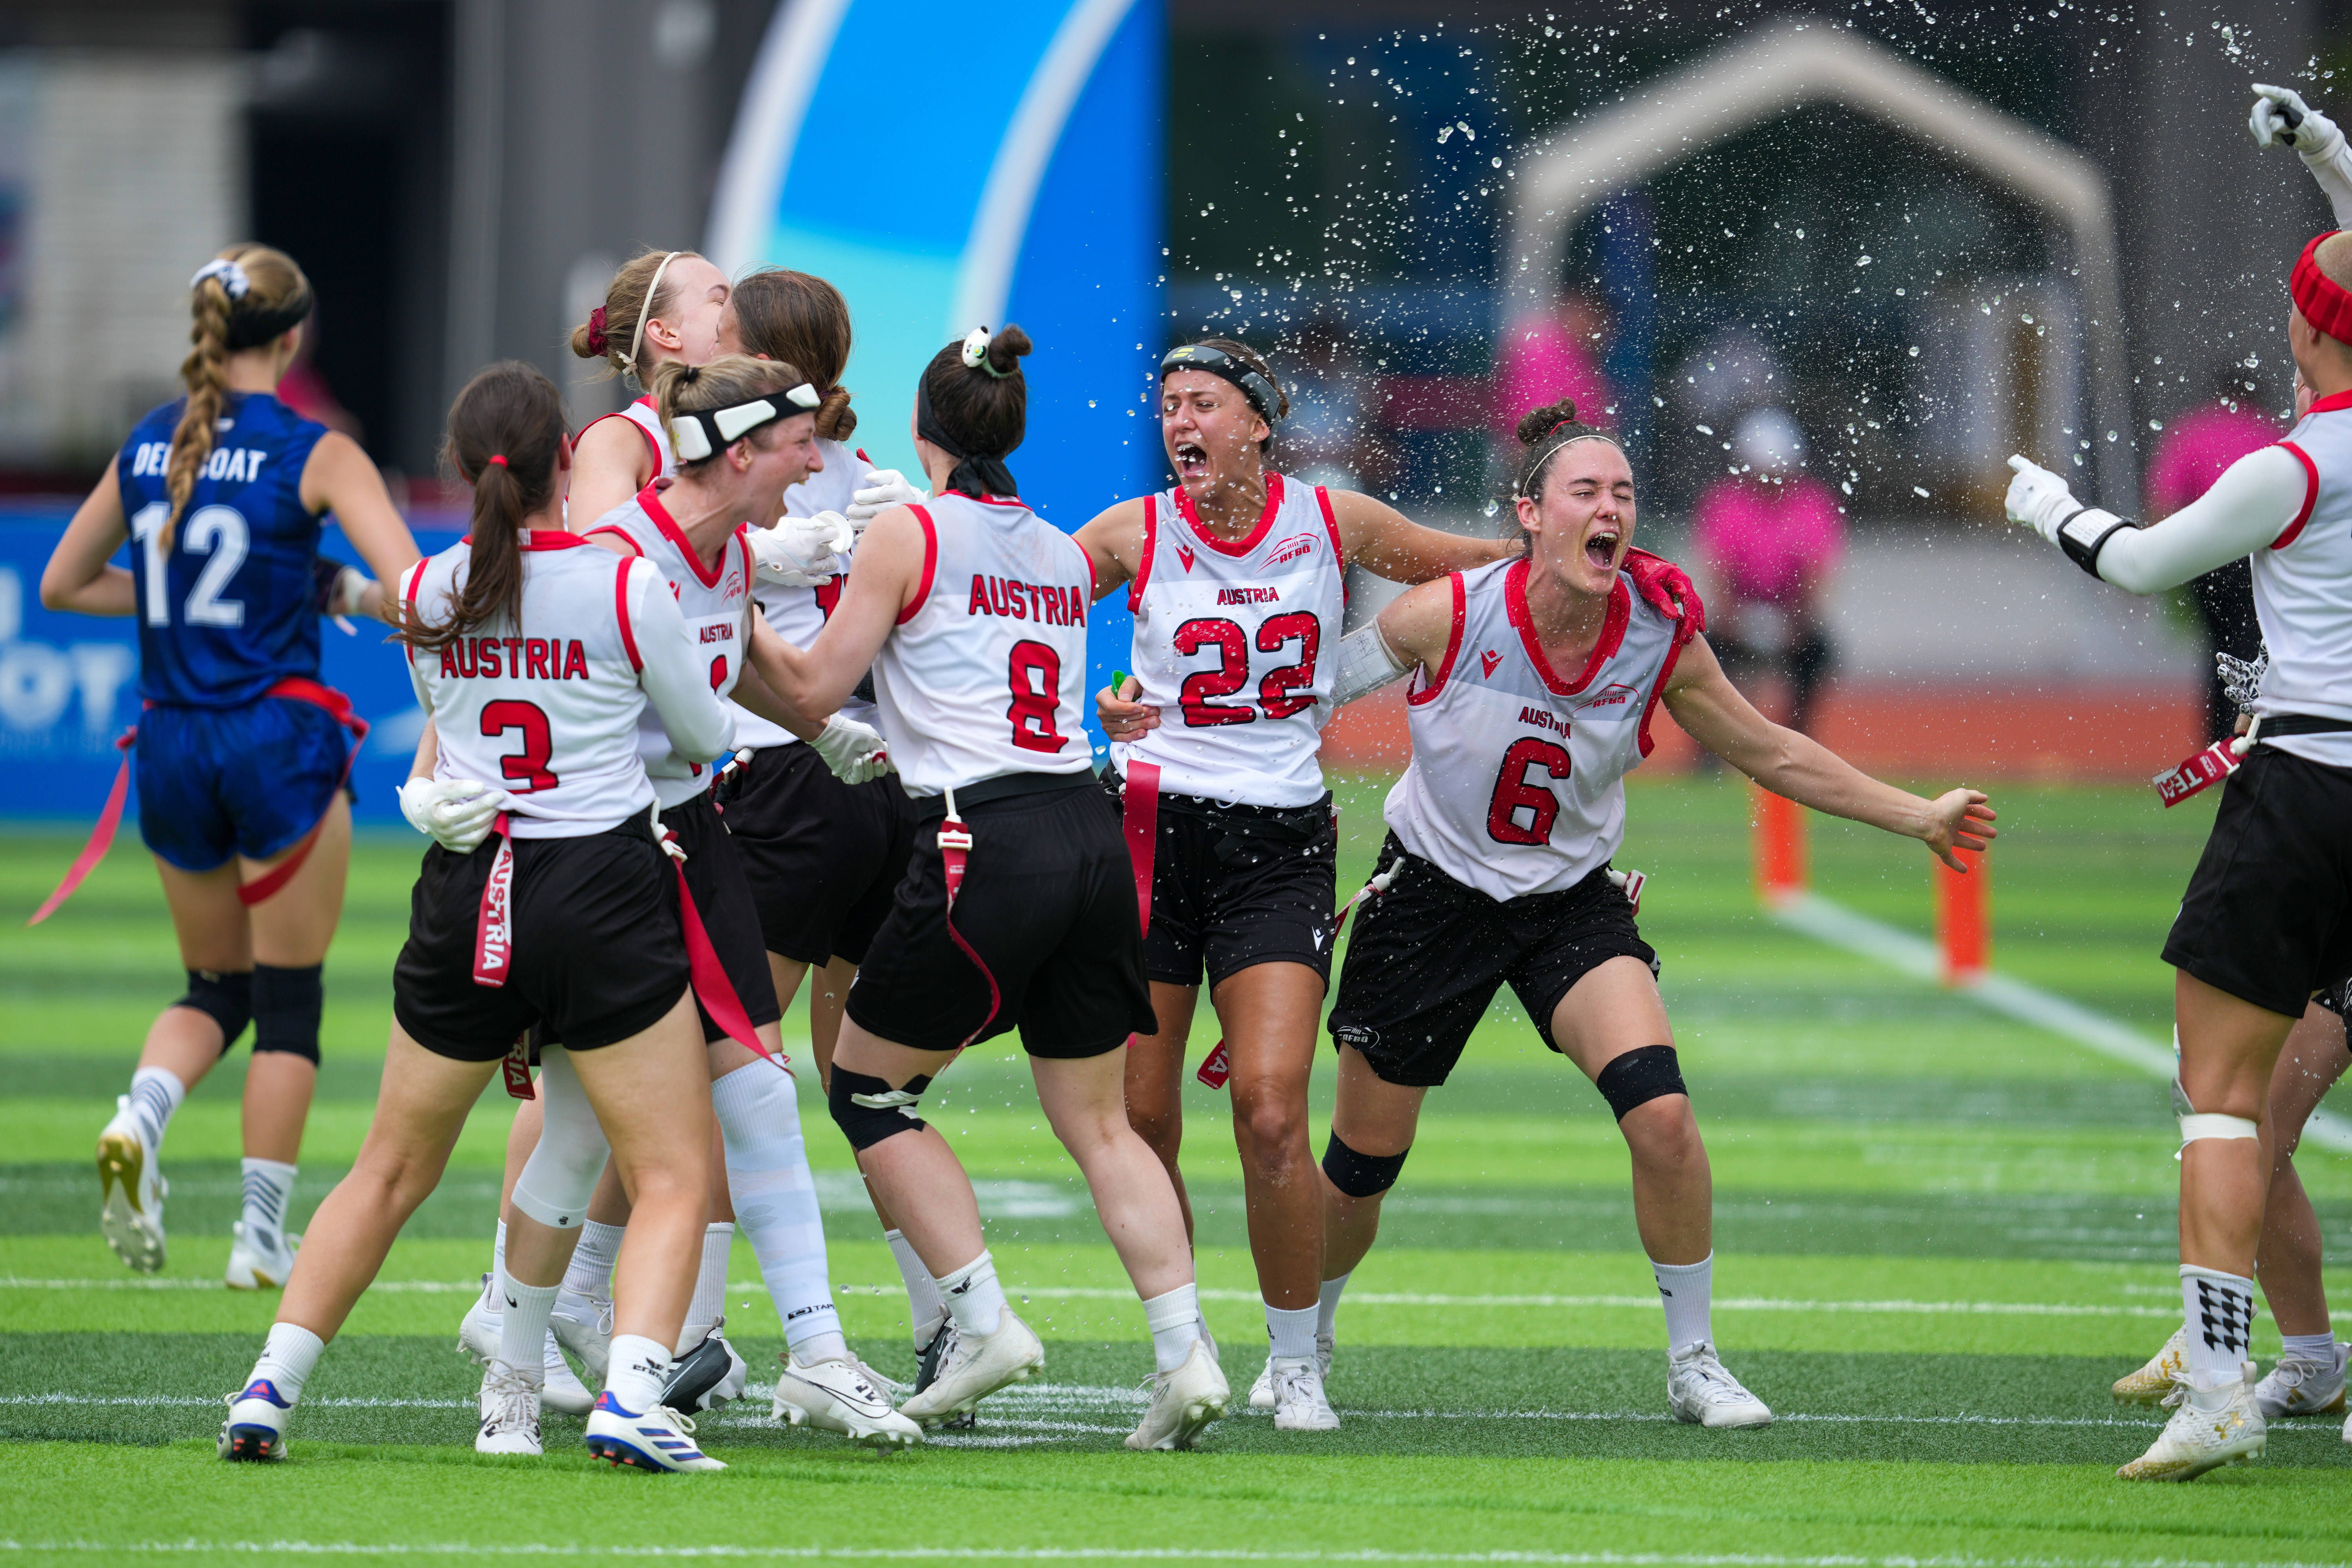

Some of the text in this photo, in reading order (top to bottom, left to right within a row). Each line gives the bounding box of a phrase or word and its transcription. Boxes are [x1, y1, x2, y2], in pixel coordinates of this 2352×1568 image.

[132, 502, 250, 628] 12
[969, 574, 1085, 628] AUSTRIA
[1216, 587, 1279, 605] AUSTRIA
[1280, 544, 1311, 564] AFBÖ
[441, 638, 589, 680] AUSTRIA
[700, 622, 733, 644] AUSTRIA
[1173, 610, 1321, 728] 22
[1007, 639, 1069, 753] 8
[480, 699, 559, 794] 3
[1486, 736, 1571, 846] 6
[482, 849, 512, 971] AUSTRIA
